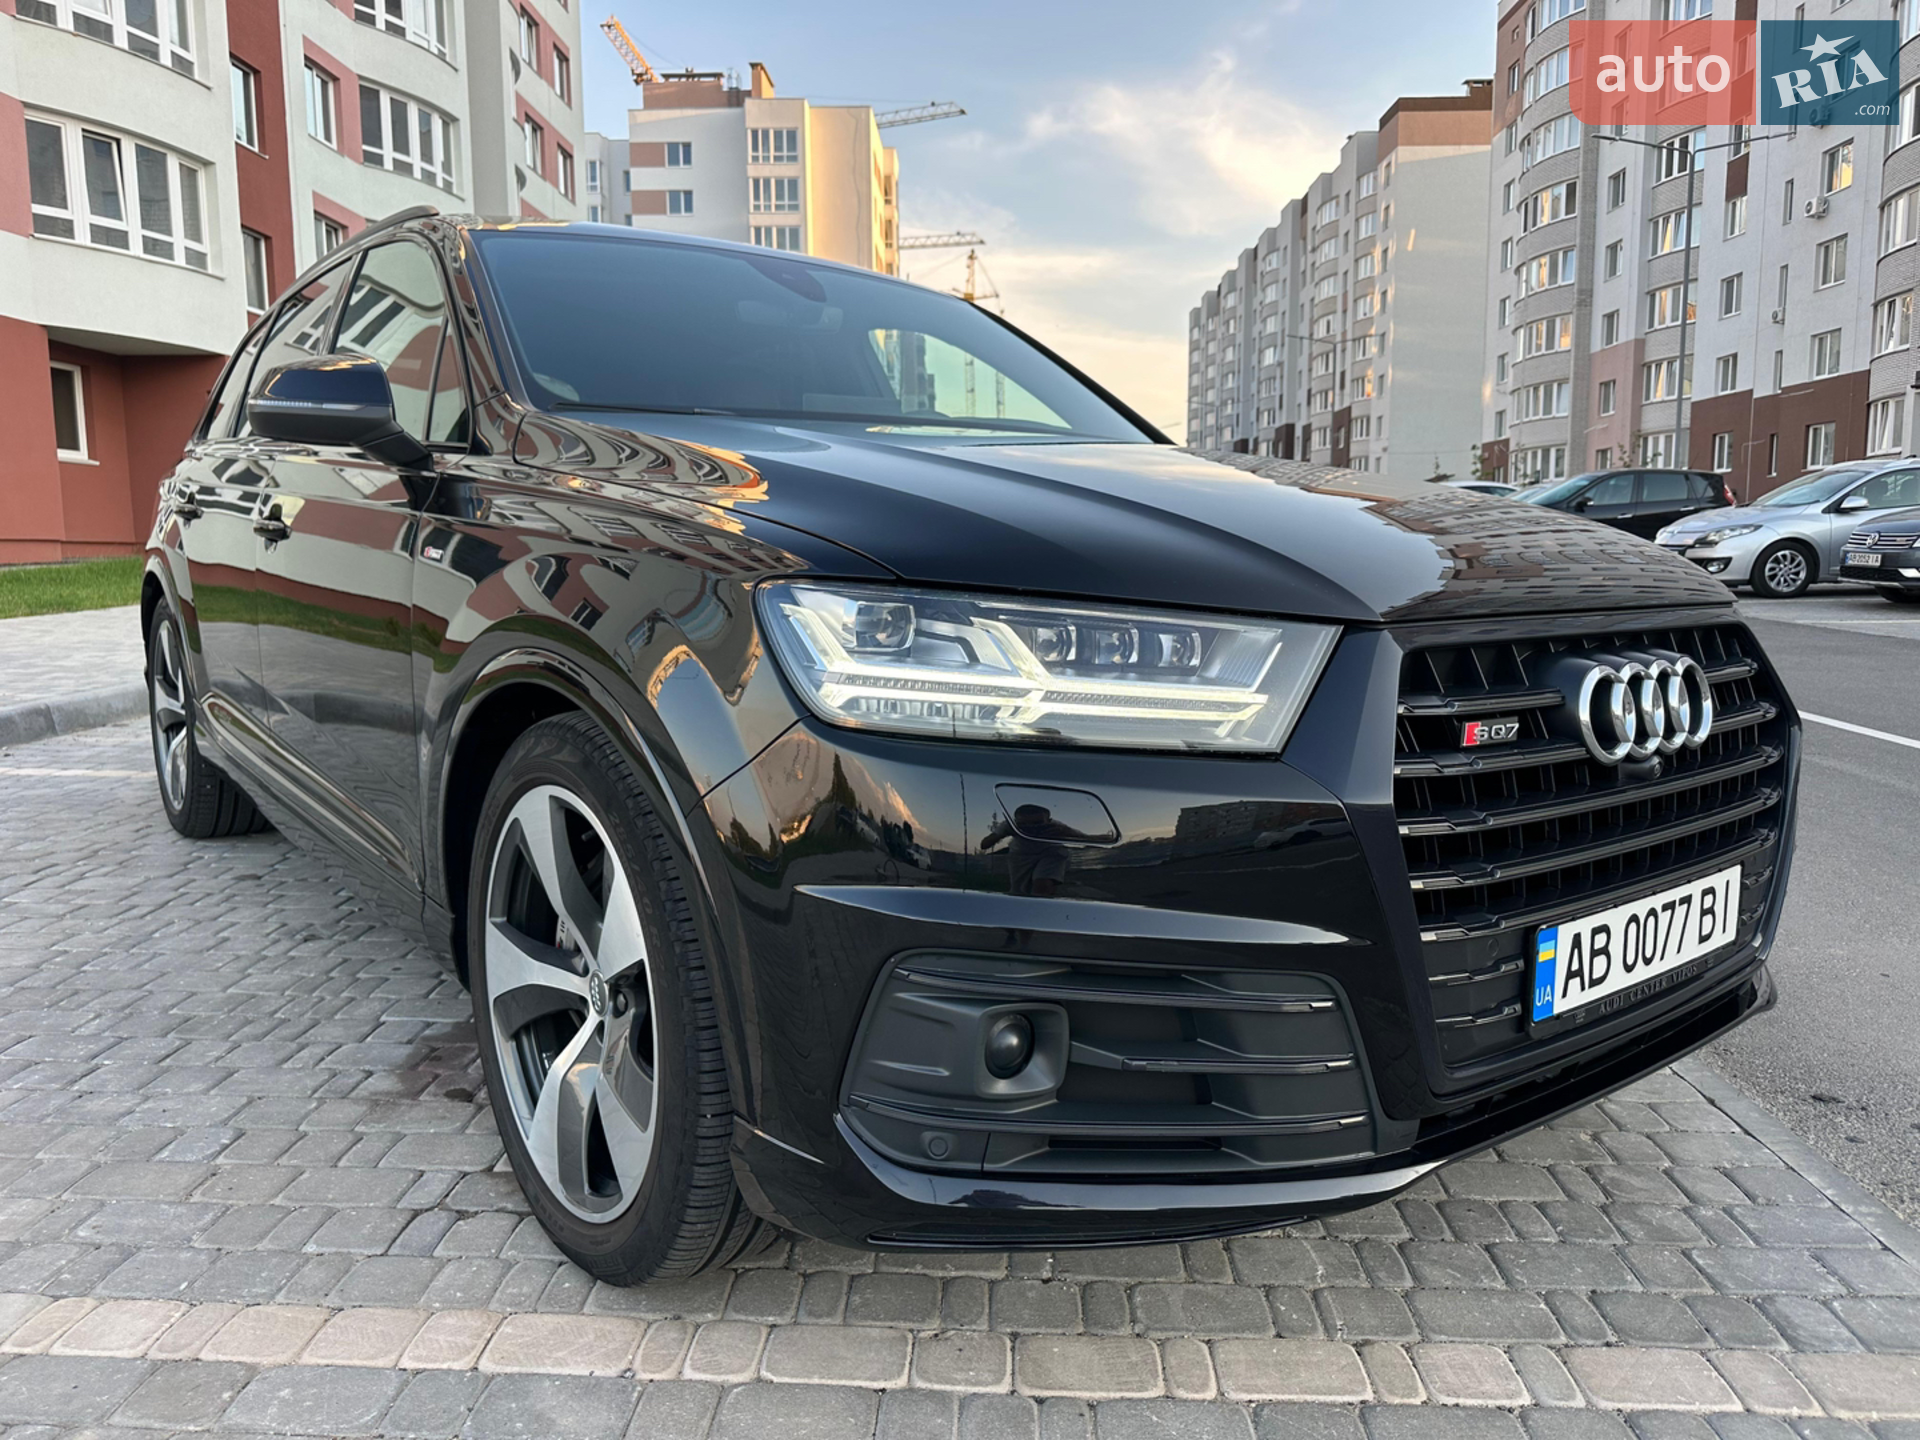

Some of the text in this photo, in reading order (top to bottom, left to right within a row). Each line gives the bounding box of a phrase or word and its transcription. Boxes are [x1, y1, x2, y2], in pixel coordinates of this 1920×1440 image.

[1473, 723, 1520, 740] SQ7
[1561, 879, 1730, 1000] AB 0077 BI
[1535, 985, 1553, 1007] UA
[1599, 994, 1624, 1014] AUDI
[1630, 976, 1668, 1001] CENTER
